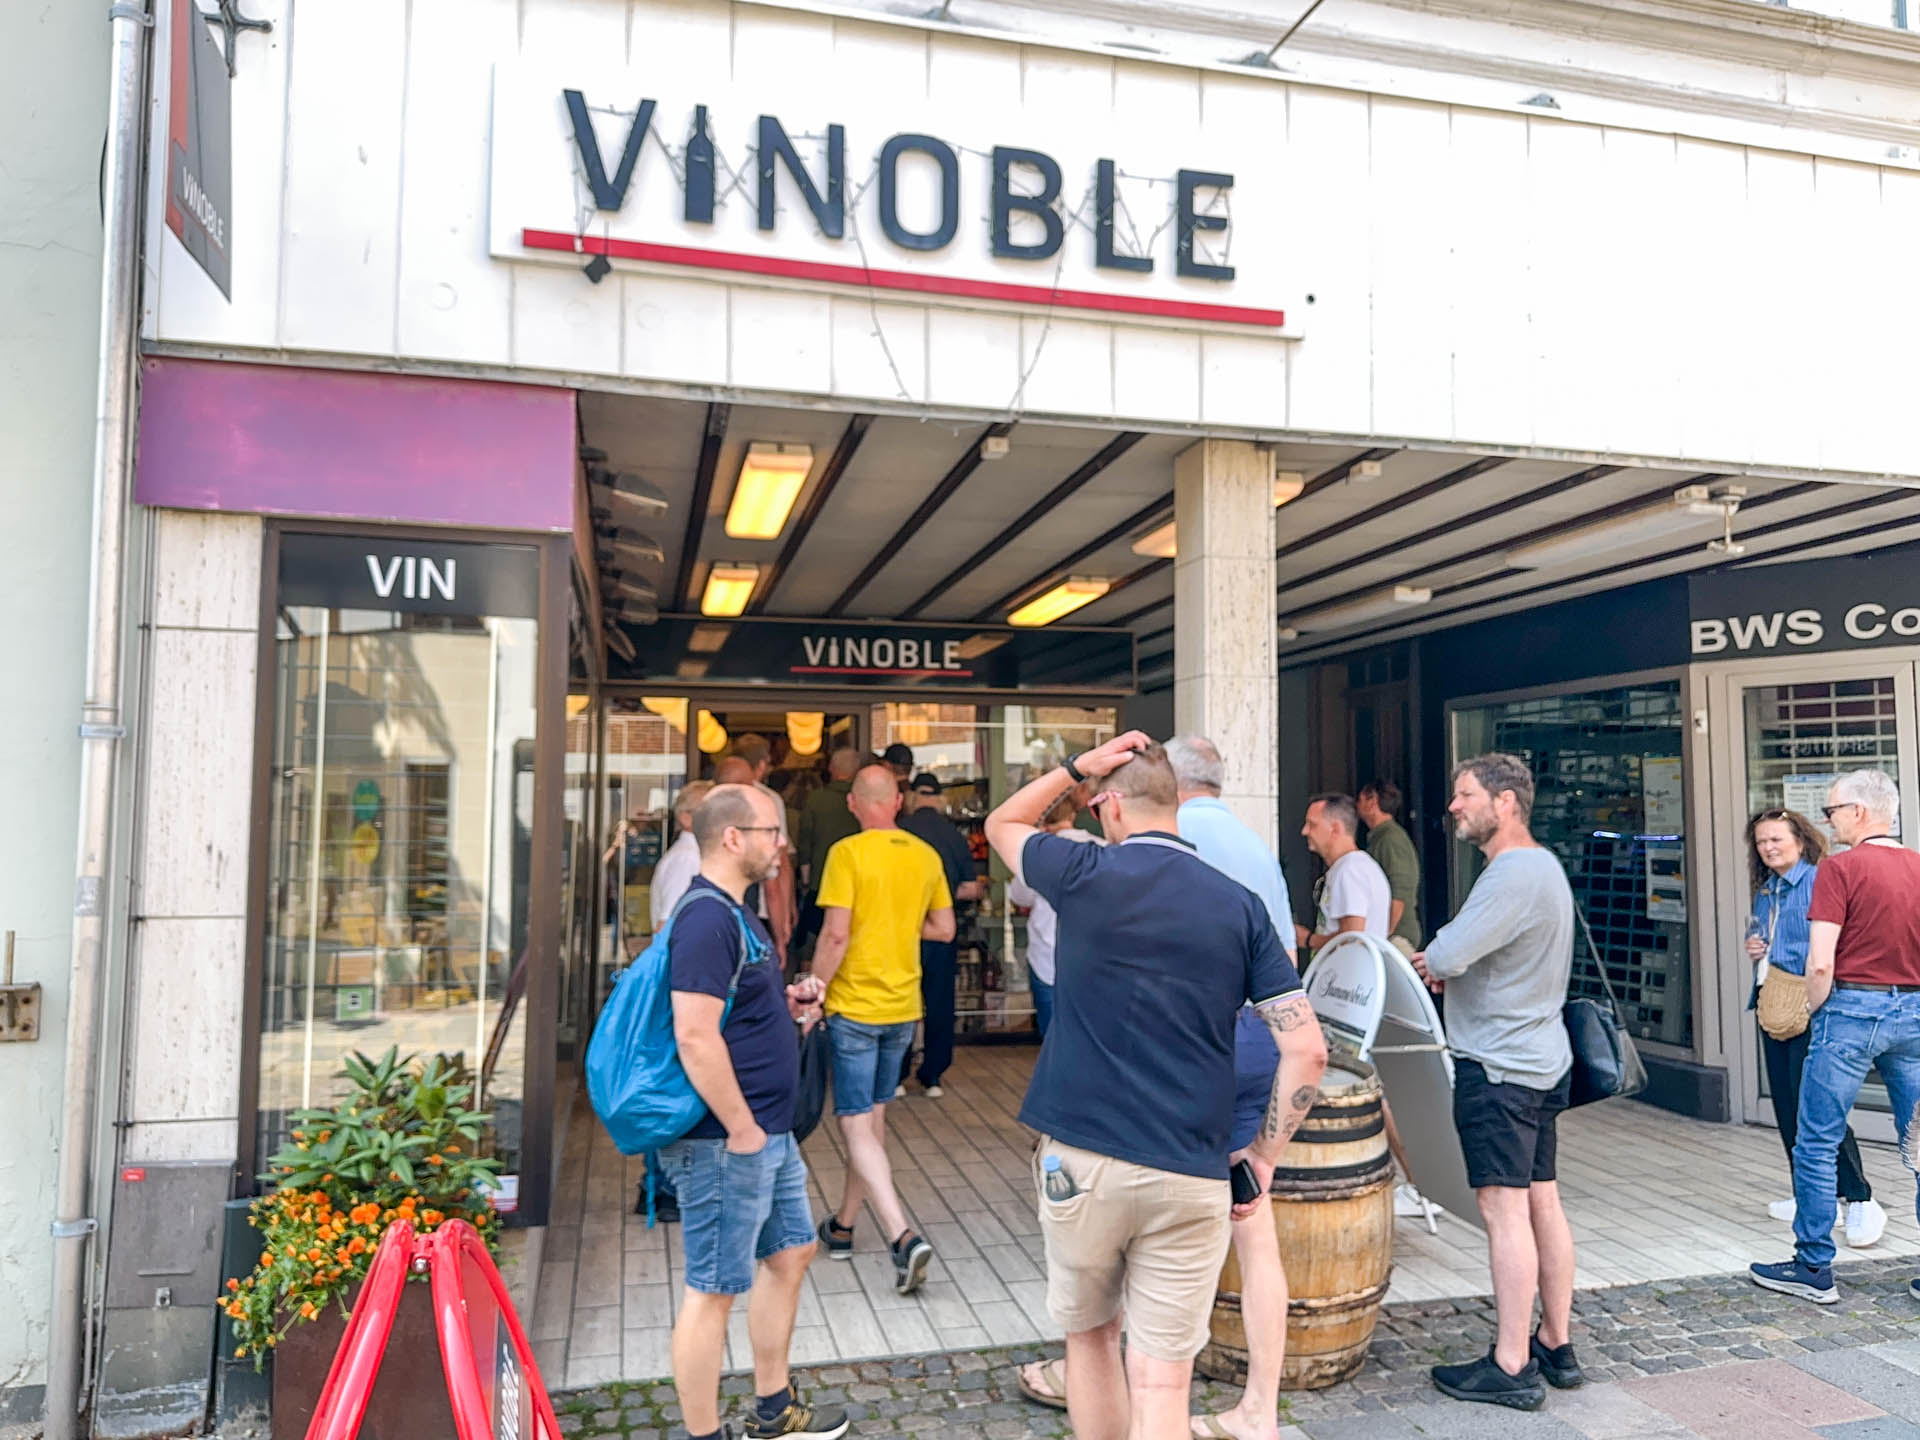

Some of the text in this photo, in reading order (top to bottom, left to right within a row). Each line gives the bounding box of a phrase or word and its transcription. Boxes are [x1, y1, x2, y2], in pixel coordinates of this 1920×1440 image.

[182, 166, 224, 249] VINOBLE
[563, 88, 1236, 281] VINOBLE
[366, 554, 457, 601] VIN
[802, 635, 962, 670] VINOBLE
[1690, 602, 1920, 654] BWS Co
